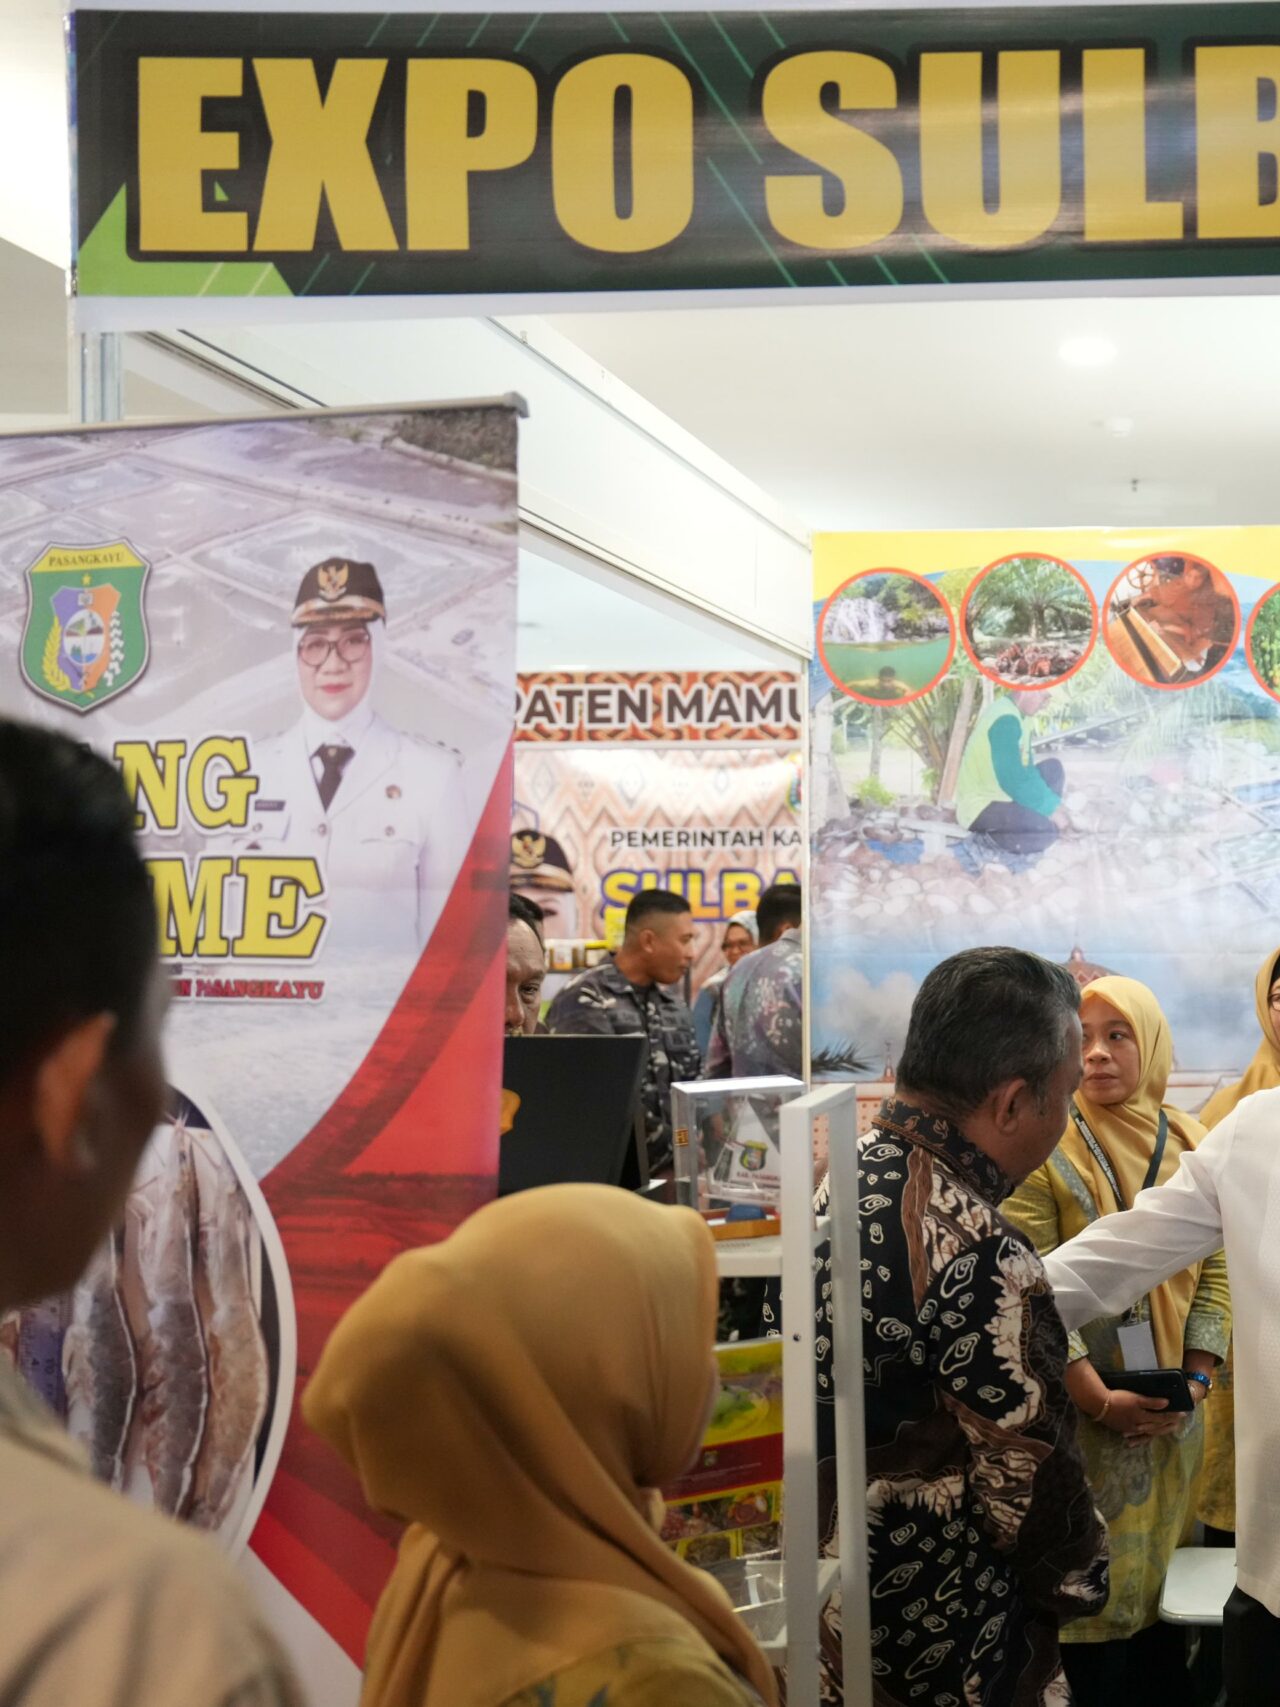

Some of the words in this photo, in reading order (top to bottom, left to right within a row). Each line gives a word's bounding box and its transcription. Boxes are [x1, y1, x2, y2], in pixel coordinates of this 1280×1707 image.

[137, 51, 694, 254] EXPO
[516, 688, 647, 724] ATEN
[610, 829, 764, 848] PEMERINTAH
